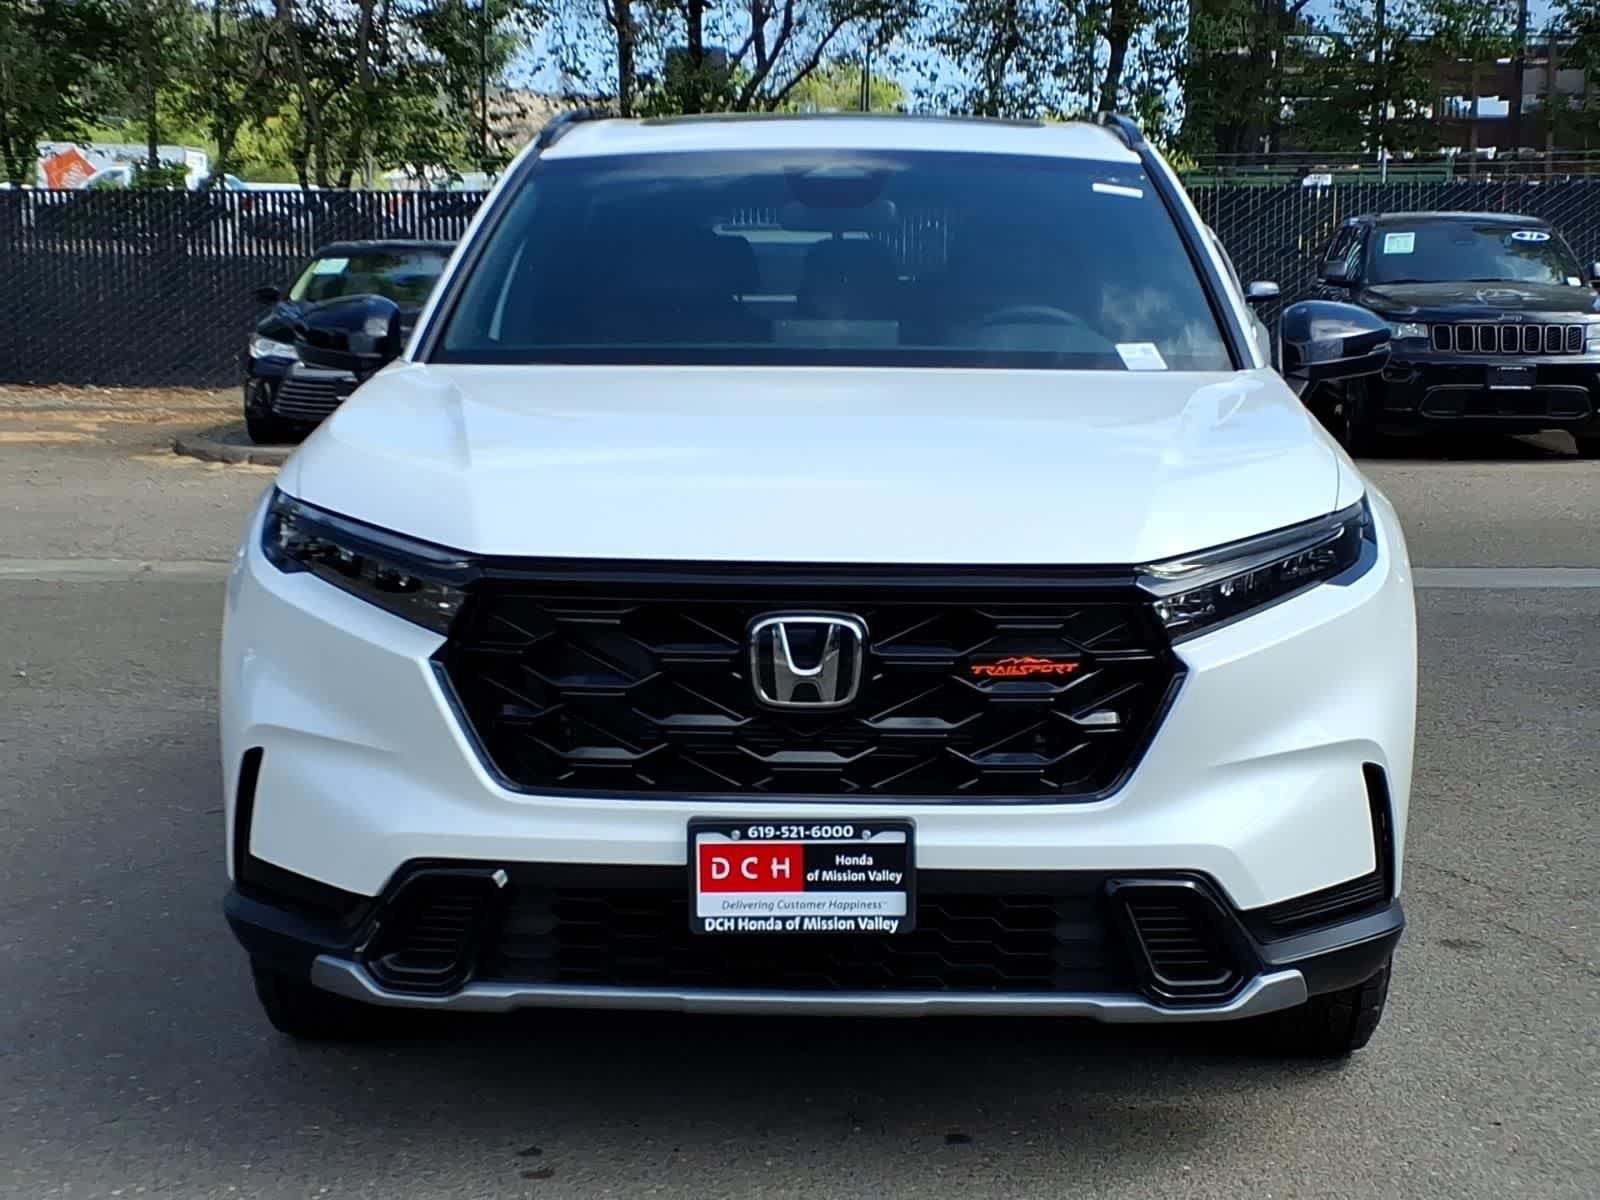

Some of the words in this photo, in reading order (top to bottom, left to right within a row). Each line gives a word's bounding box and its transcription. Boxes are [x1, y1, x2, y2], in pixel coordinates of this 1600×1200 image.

[971, 661, 1079, 676] TRAILSPORT
[747, 825, 855, 839] 619-521-6000
[835, 854, 874, 866] Honda
[806, 869, 819, 882] of
[821, 870, 866, 882] Mission
[867, 870, 903, 885] Valley
[721, 899, 777, 912] Delivering
[777, 899, 827, 910] Customer
[828, 899, 882, 912] Happiness
[704, 918, 735, 931] DCH
[737, 917, 782, 931] Honda
[785, 917, 802, 931] of
[803, 917, 855, 931] Mission
[857, 917, 900, 934] Valley
